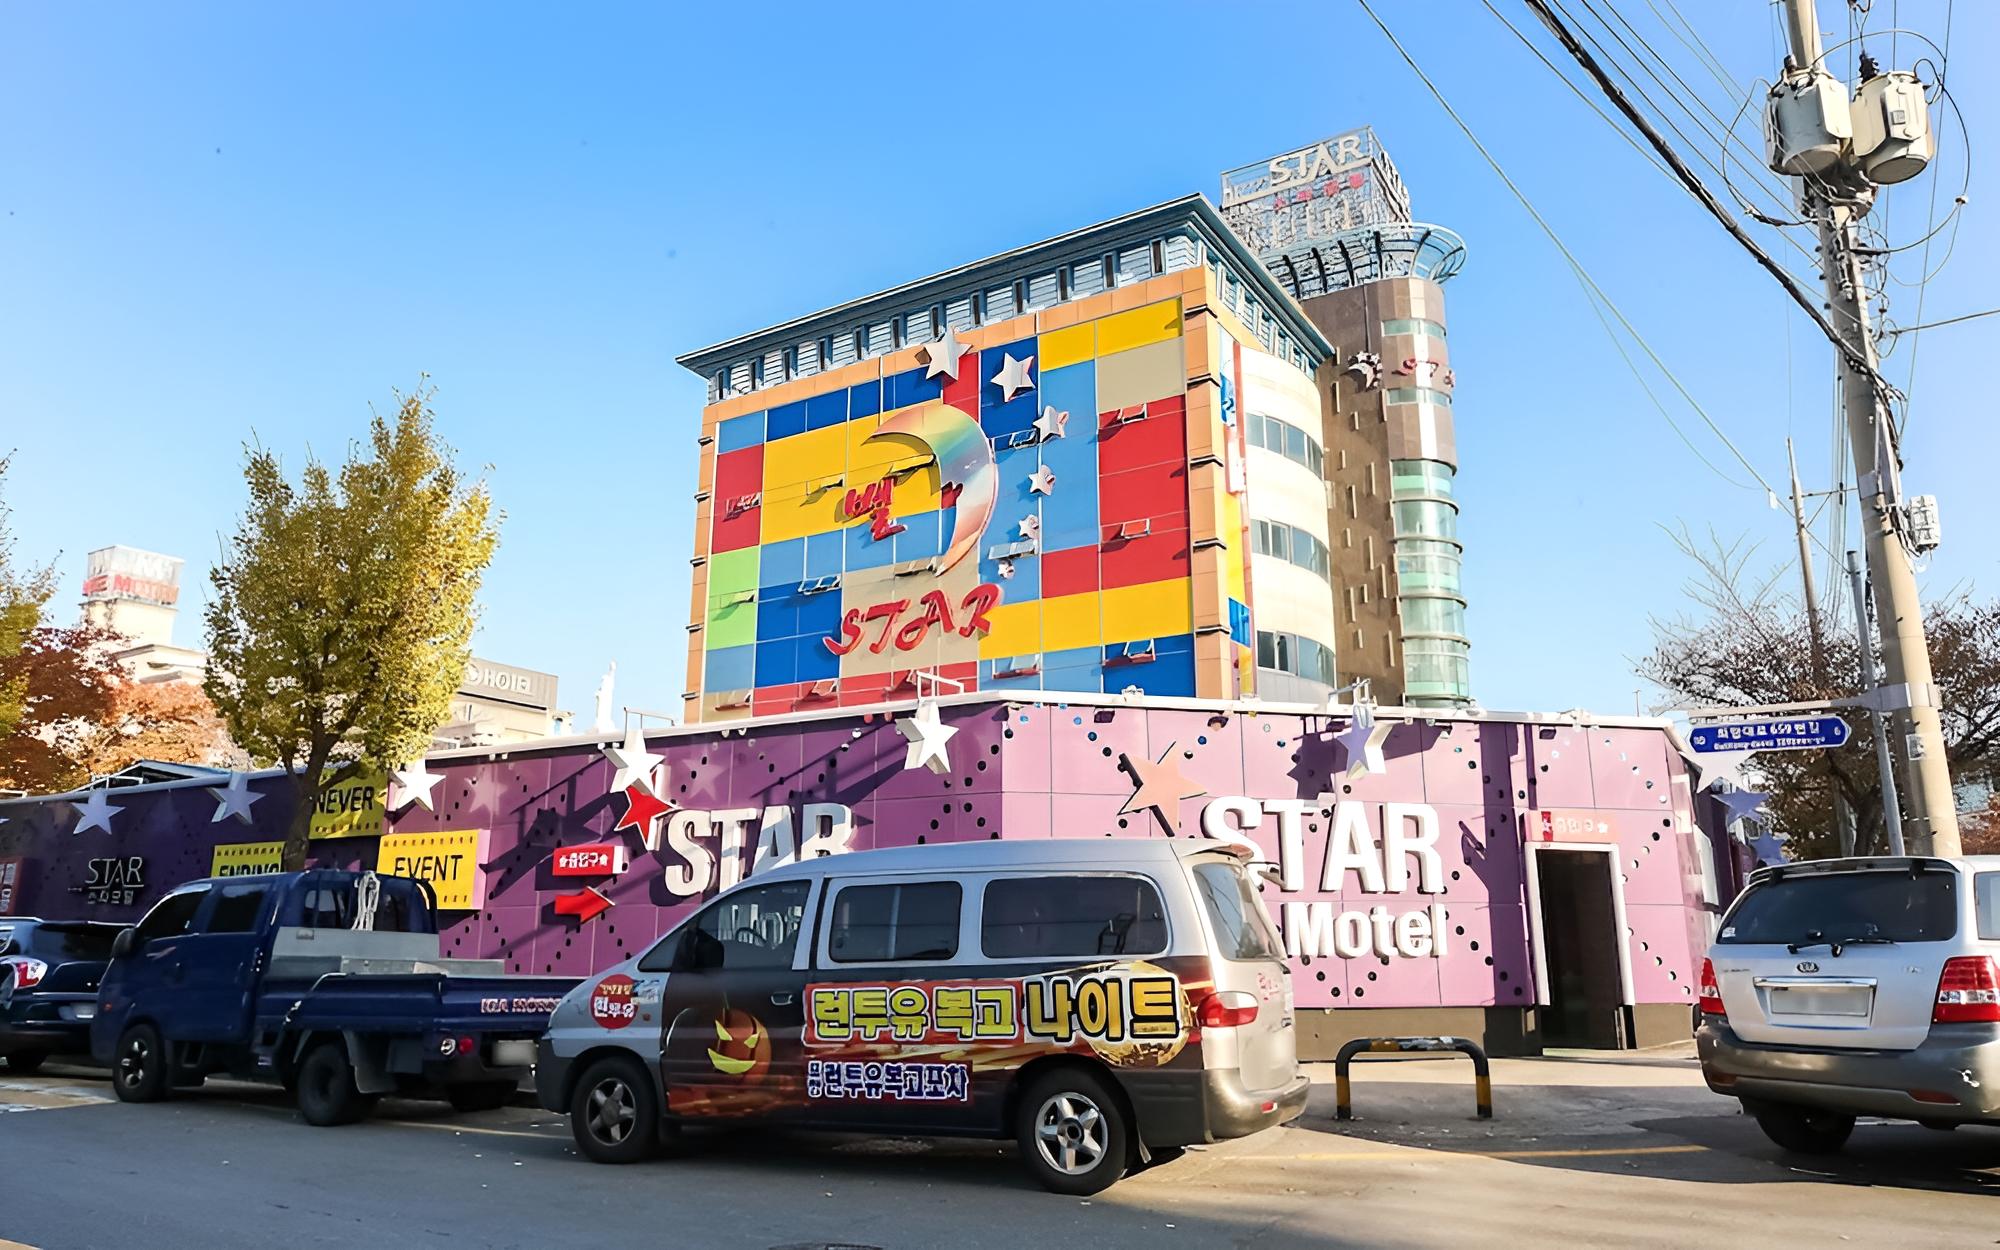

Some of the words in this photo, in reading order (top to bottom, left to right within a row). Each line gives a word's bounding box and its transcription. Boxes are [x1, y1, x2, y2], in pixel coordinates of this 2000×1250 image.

[1269, 134, 1365, 188] STAR
[822, 583, 1004, 656] STAR
[316, 786, 374, 814] NEVER
[85, 856, 144, 888] STAR
[394, 854, 463, 882] EVENT
[664, 803, 853, 897] STAR
[1200, 795, 1447, 895] STAR
[1281, 901, 1448, 958] Motel
[812, 987, 928, 1040] 런투유
[933, 986, 1018, 1039] 복고
[1024, 977, 1182, 1042] 나이트
